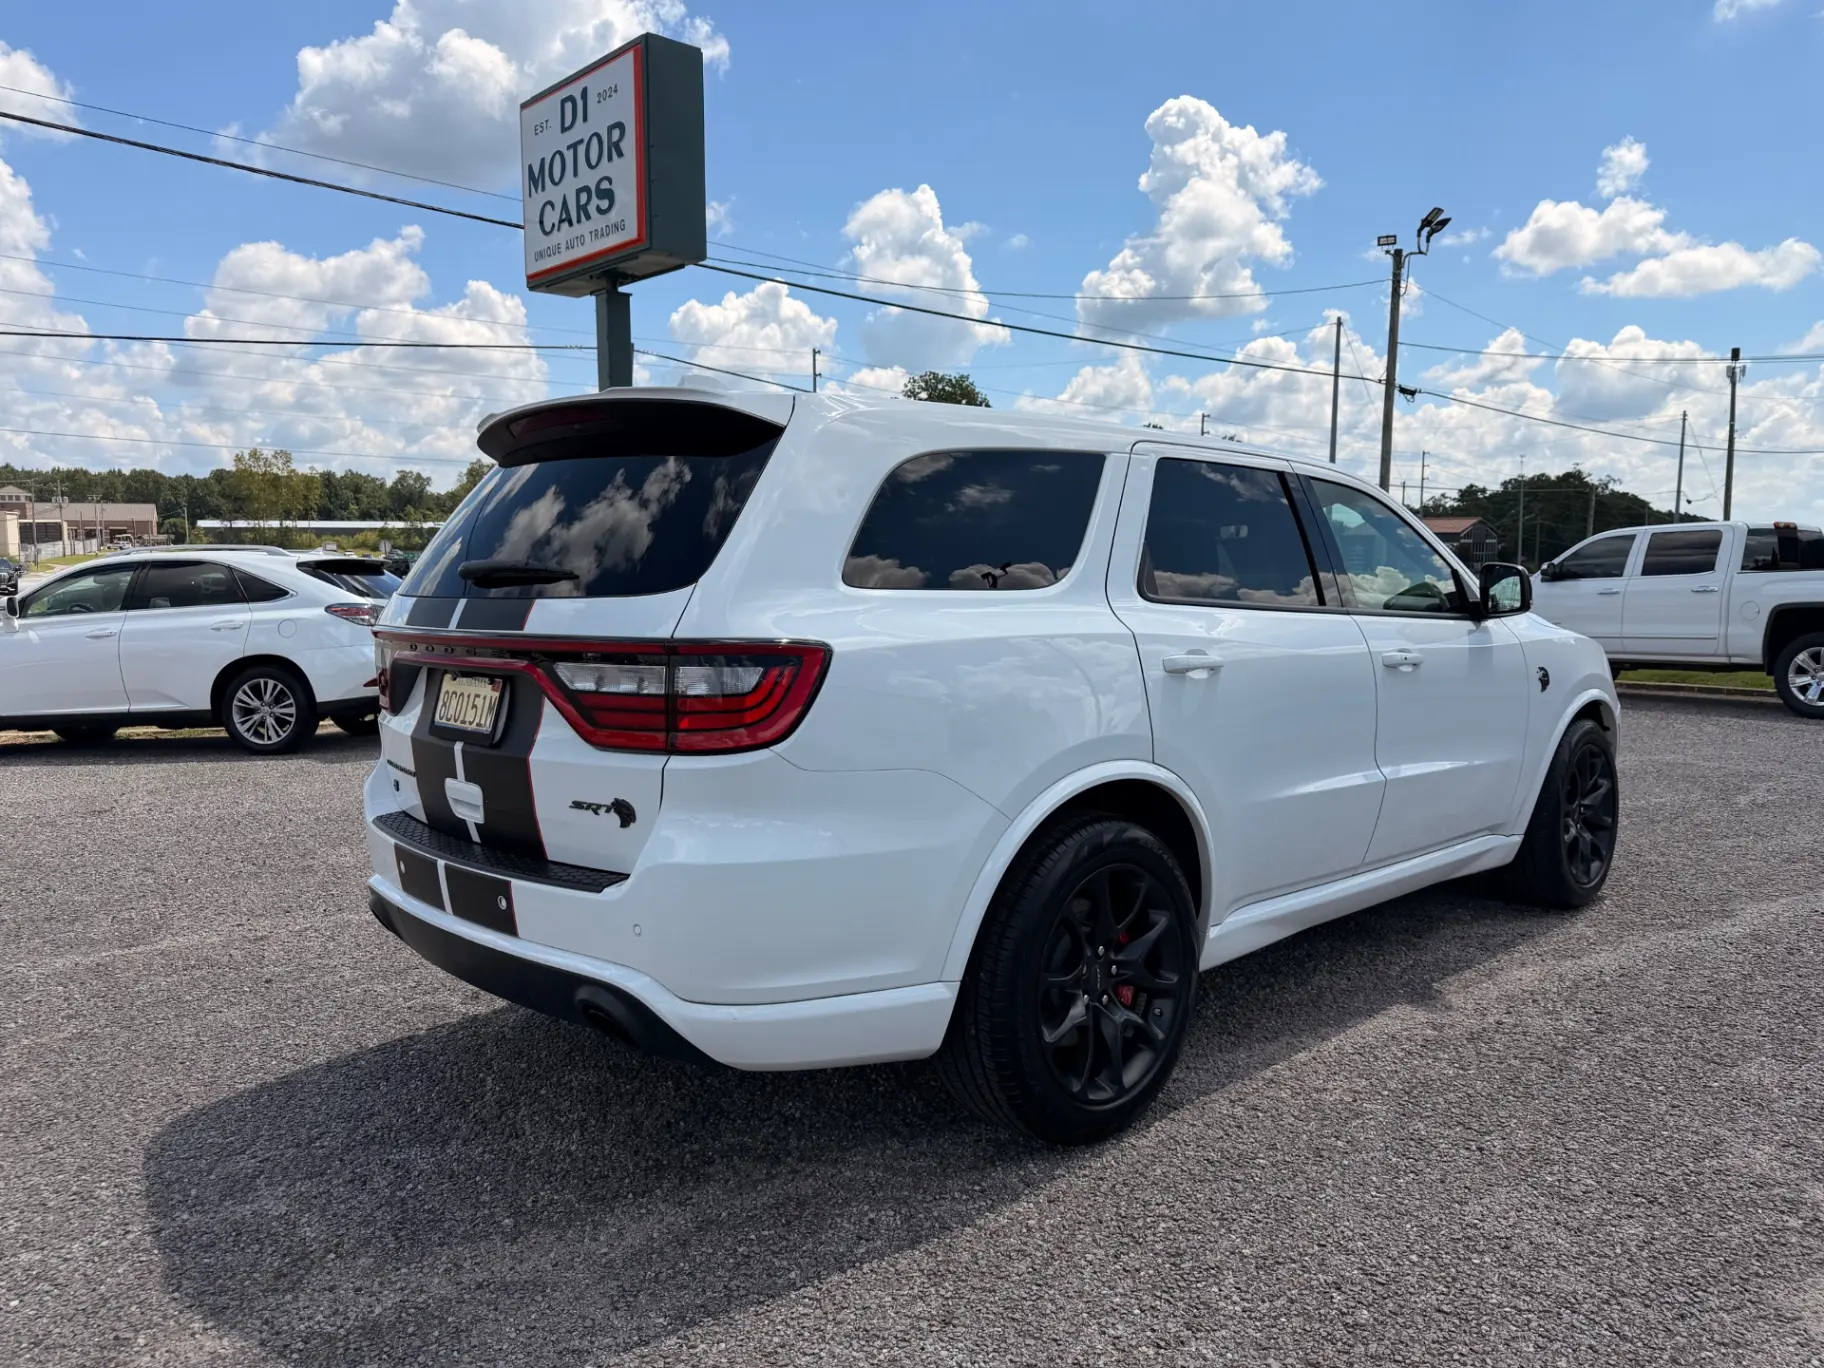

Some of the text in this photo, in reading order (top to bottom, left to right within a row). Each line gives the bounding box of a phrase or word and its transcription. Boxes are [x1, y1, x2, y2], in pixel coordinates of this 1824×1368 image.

[534, 83, 619, 136] EST. D1 2024
[527, 121, 626, 198] MOTOR
[539, 175, 616, 236] CARS
[534, 219, 626, 262] UNIQUE AUTO TRADING
[568, 799, 613, 816] SRT
